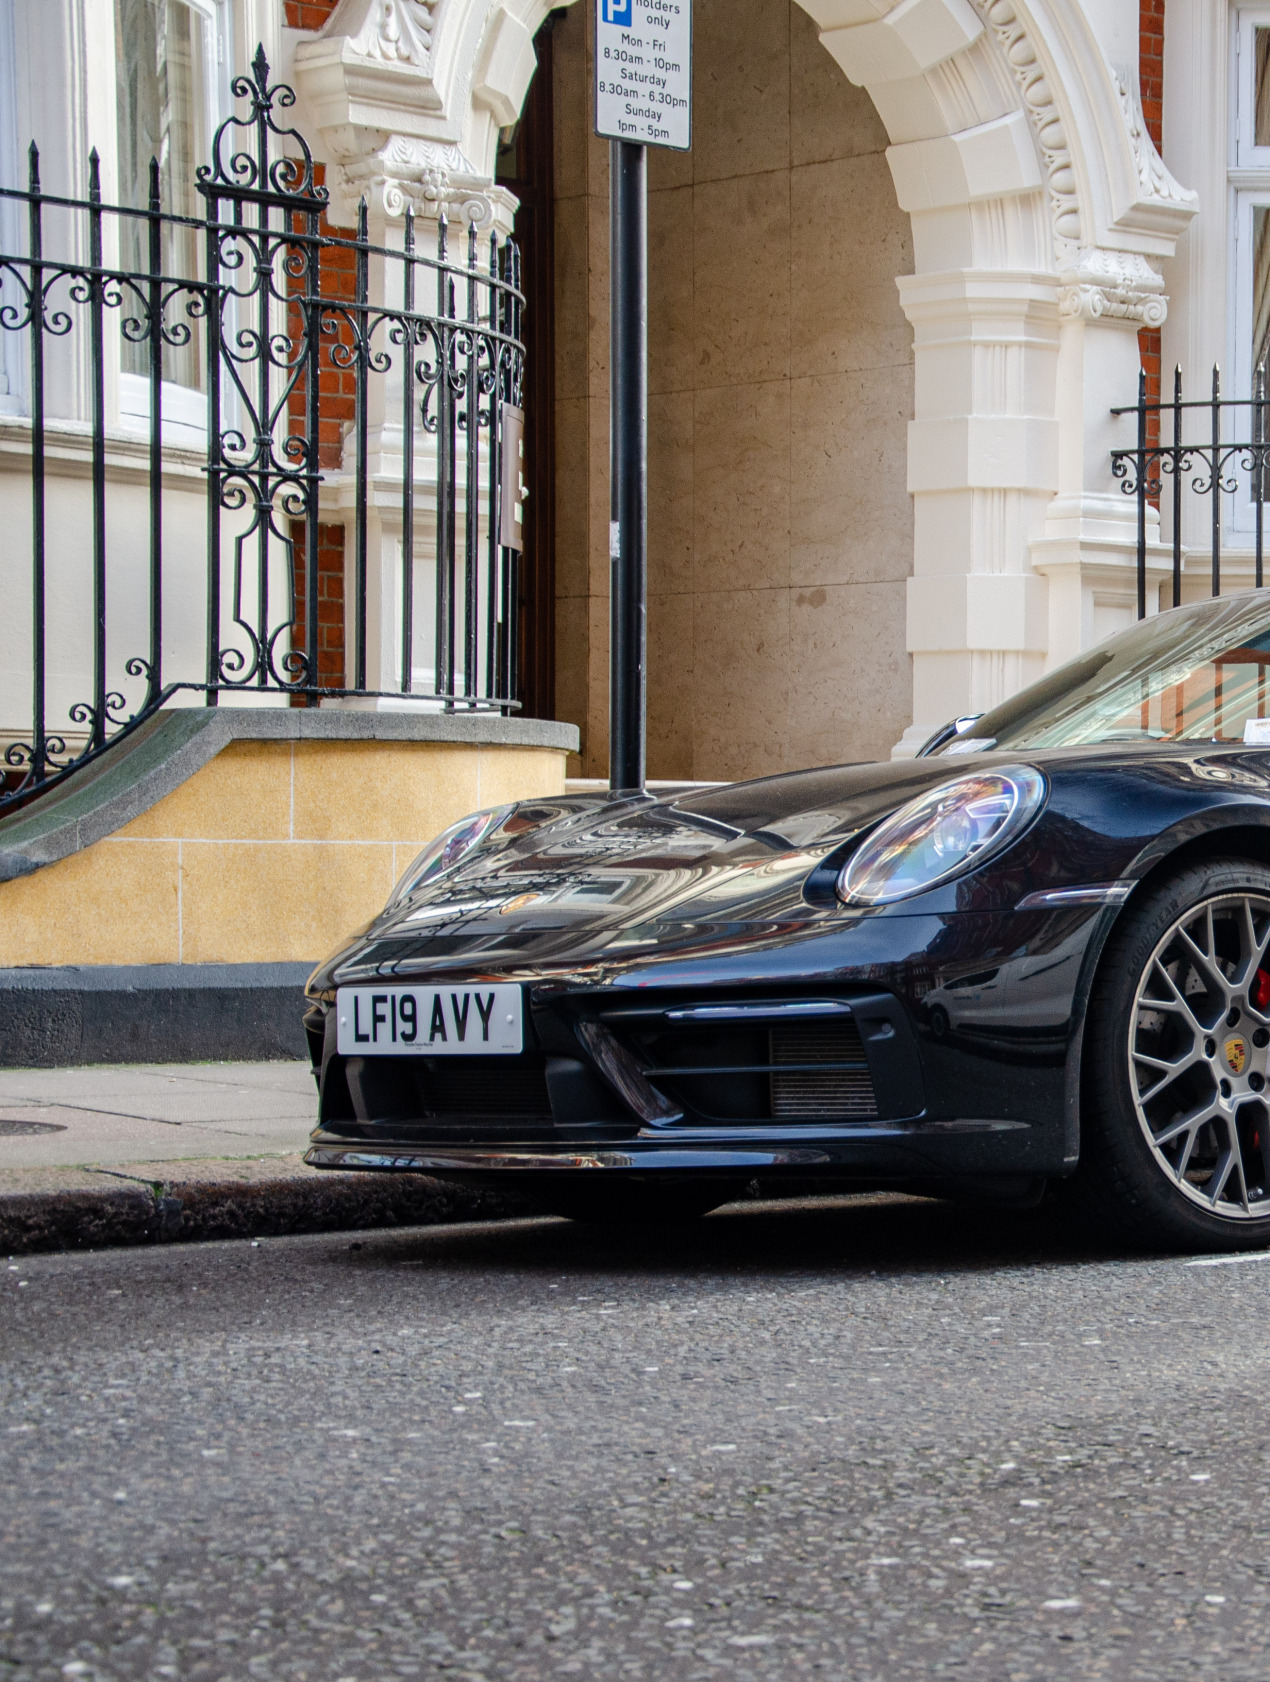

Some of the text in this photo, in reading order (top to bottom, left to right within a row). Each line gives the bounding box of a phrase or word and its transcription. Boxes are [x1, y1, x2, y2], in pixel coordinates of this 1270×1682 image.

[646, 15, 671, 30] only
[621, 33, 643, 48] Mon
[653, 39, 666, 52] Fri
[604, 47, 643, 65] 8.30am
[654, 57, 681, 73] 10pm
[621, 68, 667, 89] Saturday
[599, 81, 639, 99] 8.30am
[649, 91, 688, 108] 6.30pm
[625, 103, 662, 123] Sunday
[617, 119, 637, 133] 1pm
[647, 125, 670, 139] 5pm
[354, 992, 496, 1043] LF19 AVY
